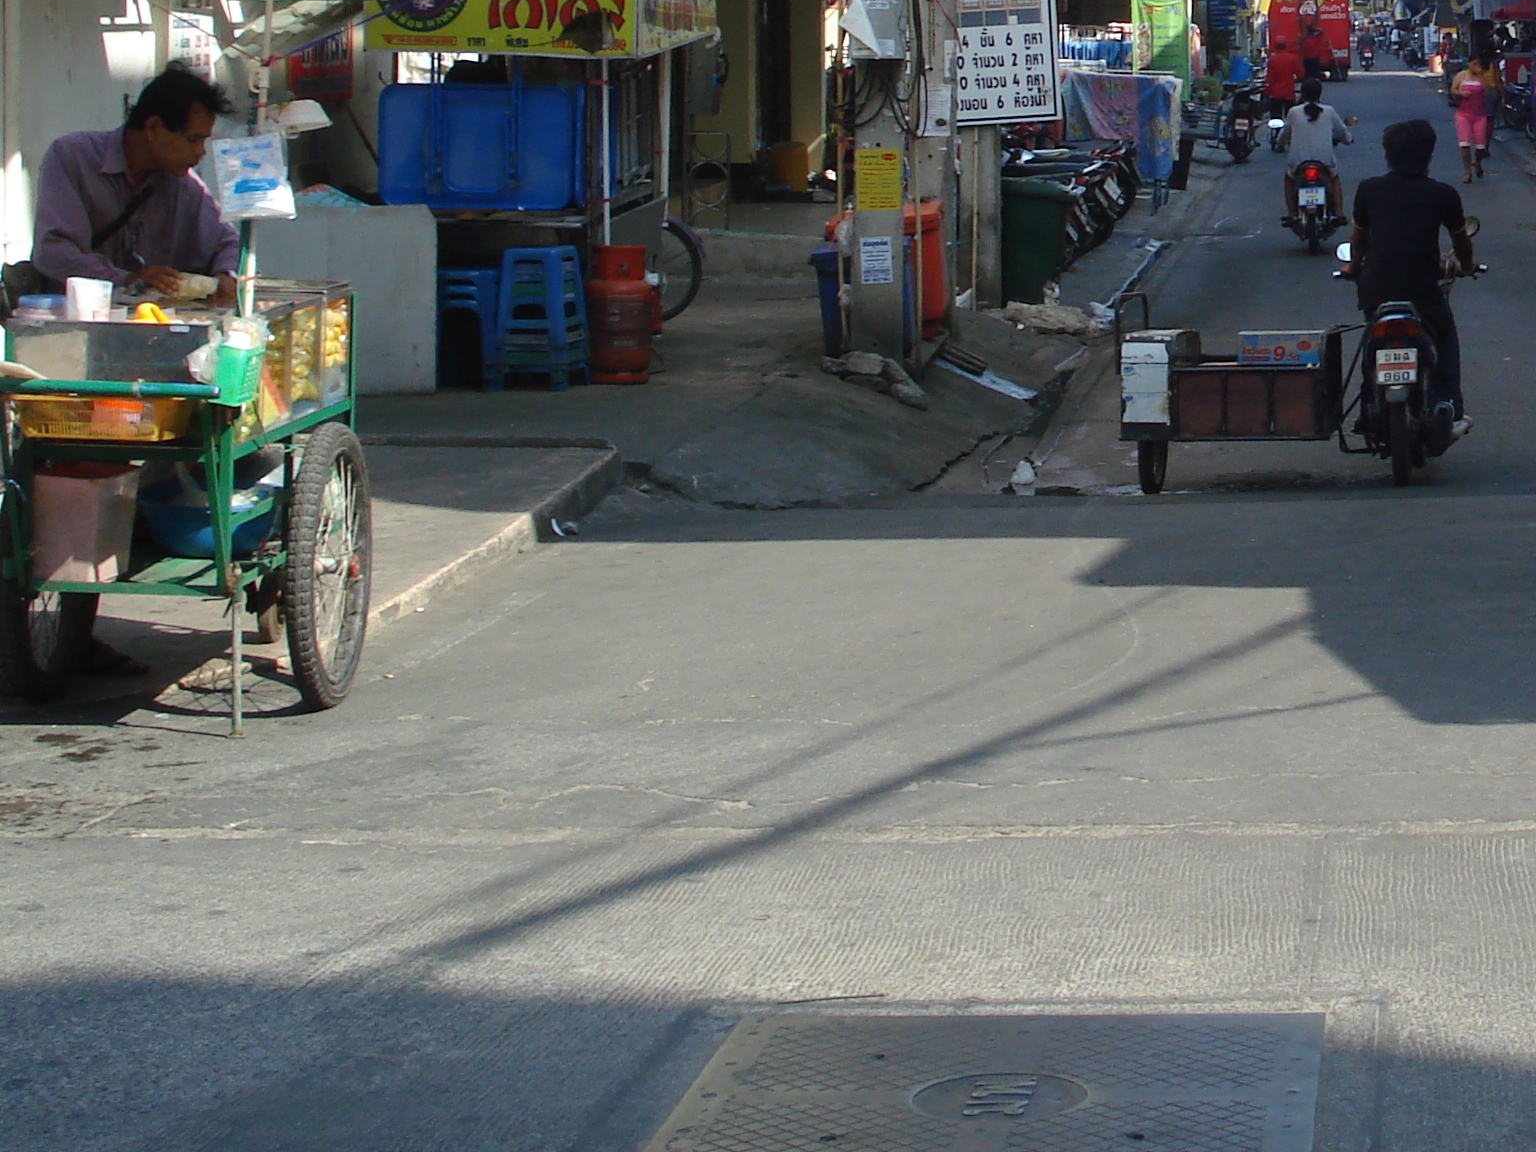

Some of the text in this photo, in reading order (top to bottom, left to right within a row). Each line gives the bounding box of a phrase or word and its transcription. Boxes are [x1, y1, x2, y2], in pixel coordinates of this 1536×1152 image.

[980, 28, 995, 48] ชั้น
[1005, 32, 1013, 47] 6
[1024, 32, 1043, 50] คูหา
[972, 52, 1005, 69] จำนวน
[1011, 52, 1018, 67] 2
[1025, 53, 1044, 70] คูหา
[974, 73, 1007, 90] จำนวน
[1013, 73, 1020, 87] 4
[1026, 74, 1045, 91] คูหา
[997, 95, 1005, 109] 6
[1383, 370, 1411, 383] 960
